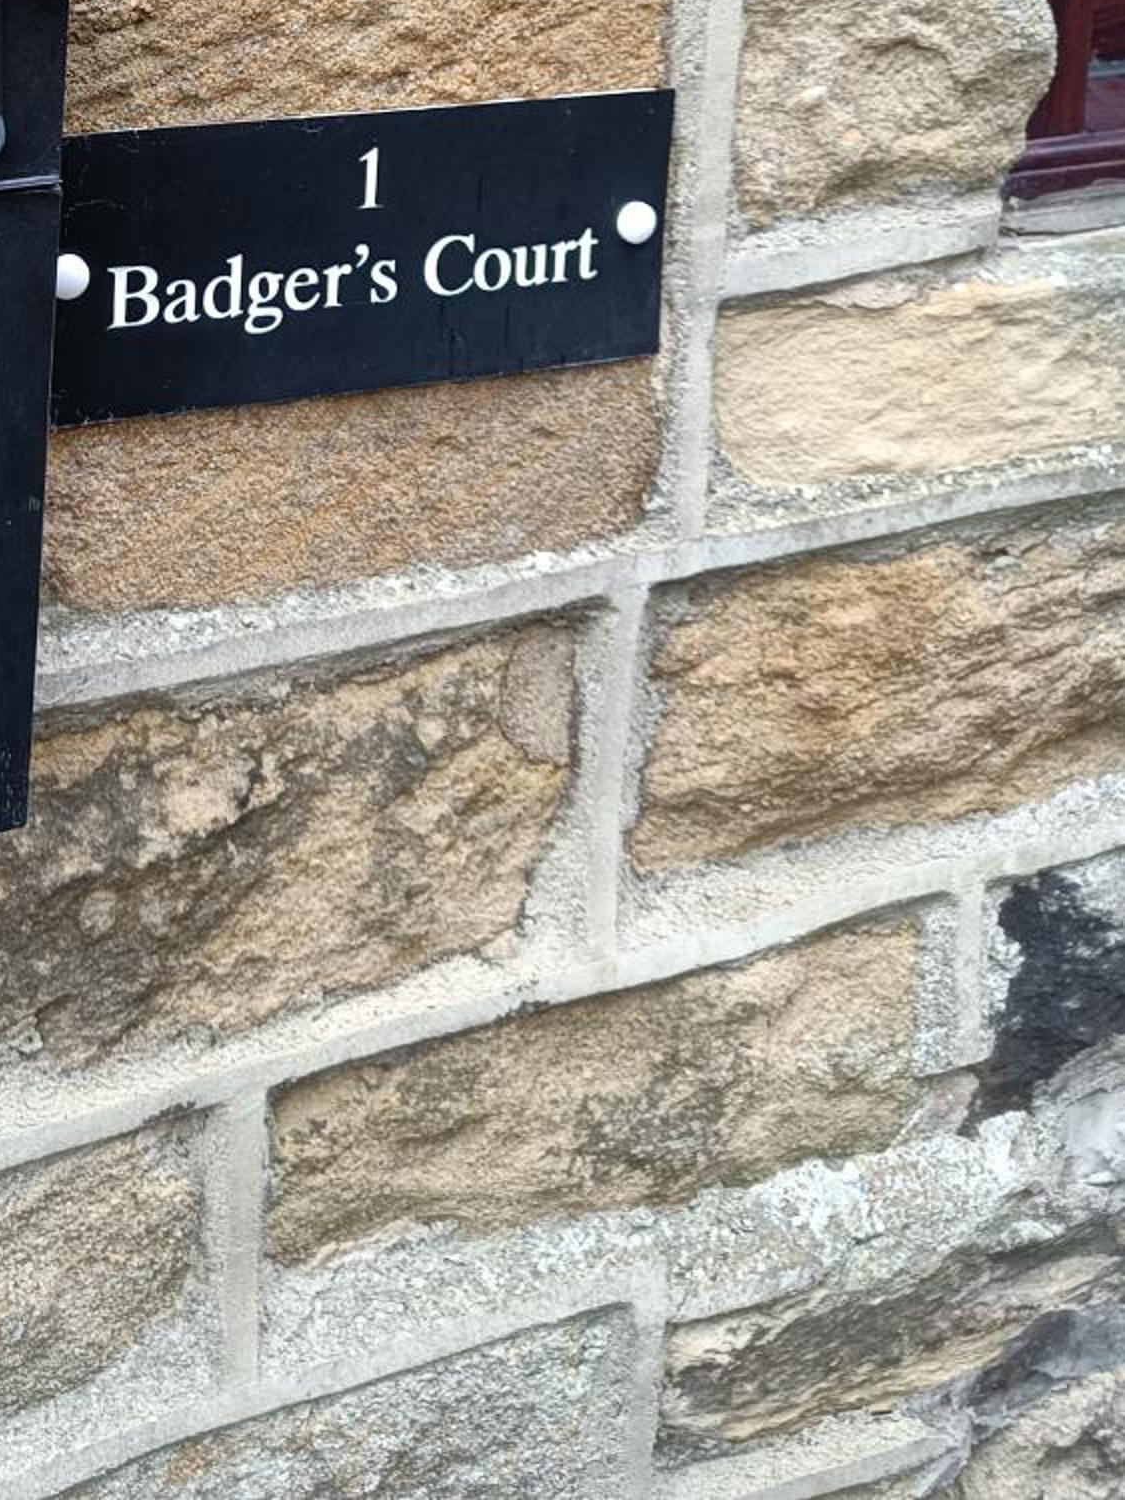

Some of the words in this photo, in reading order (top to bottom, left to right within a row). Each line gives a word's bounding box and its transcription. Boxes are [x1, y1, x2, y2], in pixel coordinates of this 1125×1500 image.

[358, 145, 384, 210] 1
[106, 244, 397, 334] Badger's
[423, 227, 598, 296] Court
